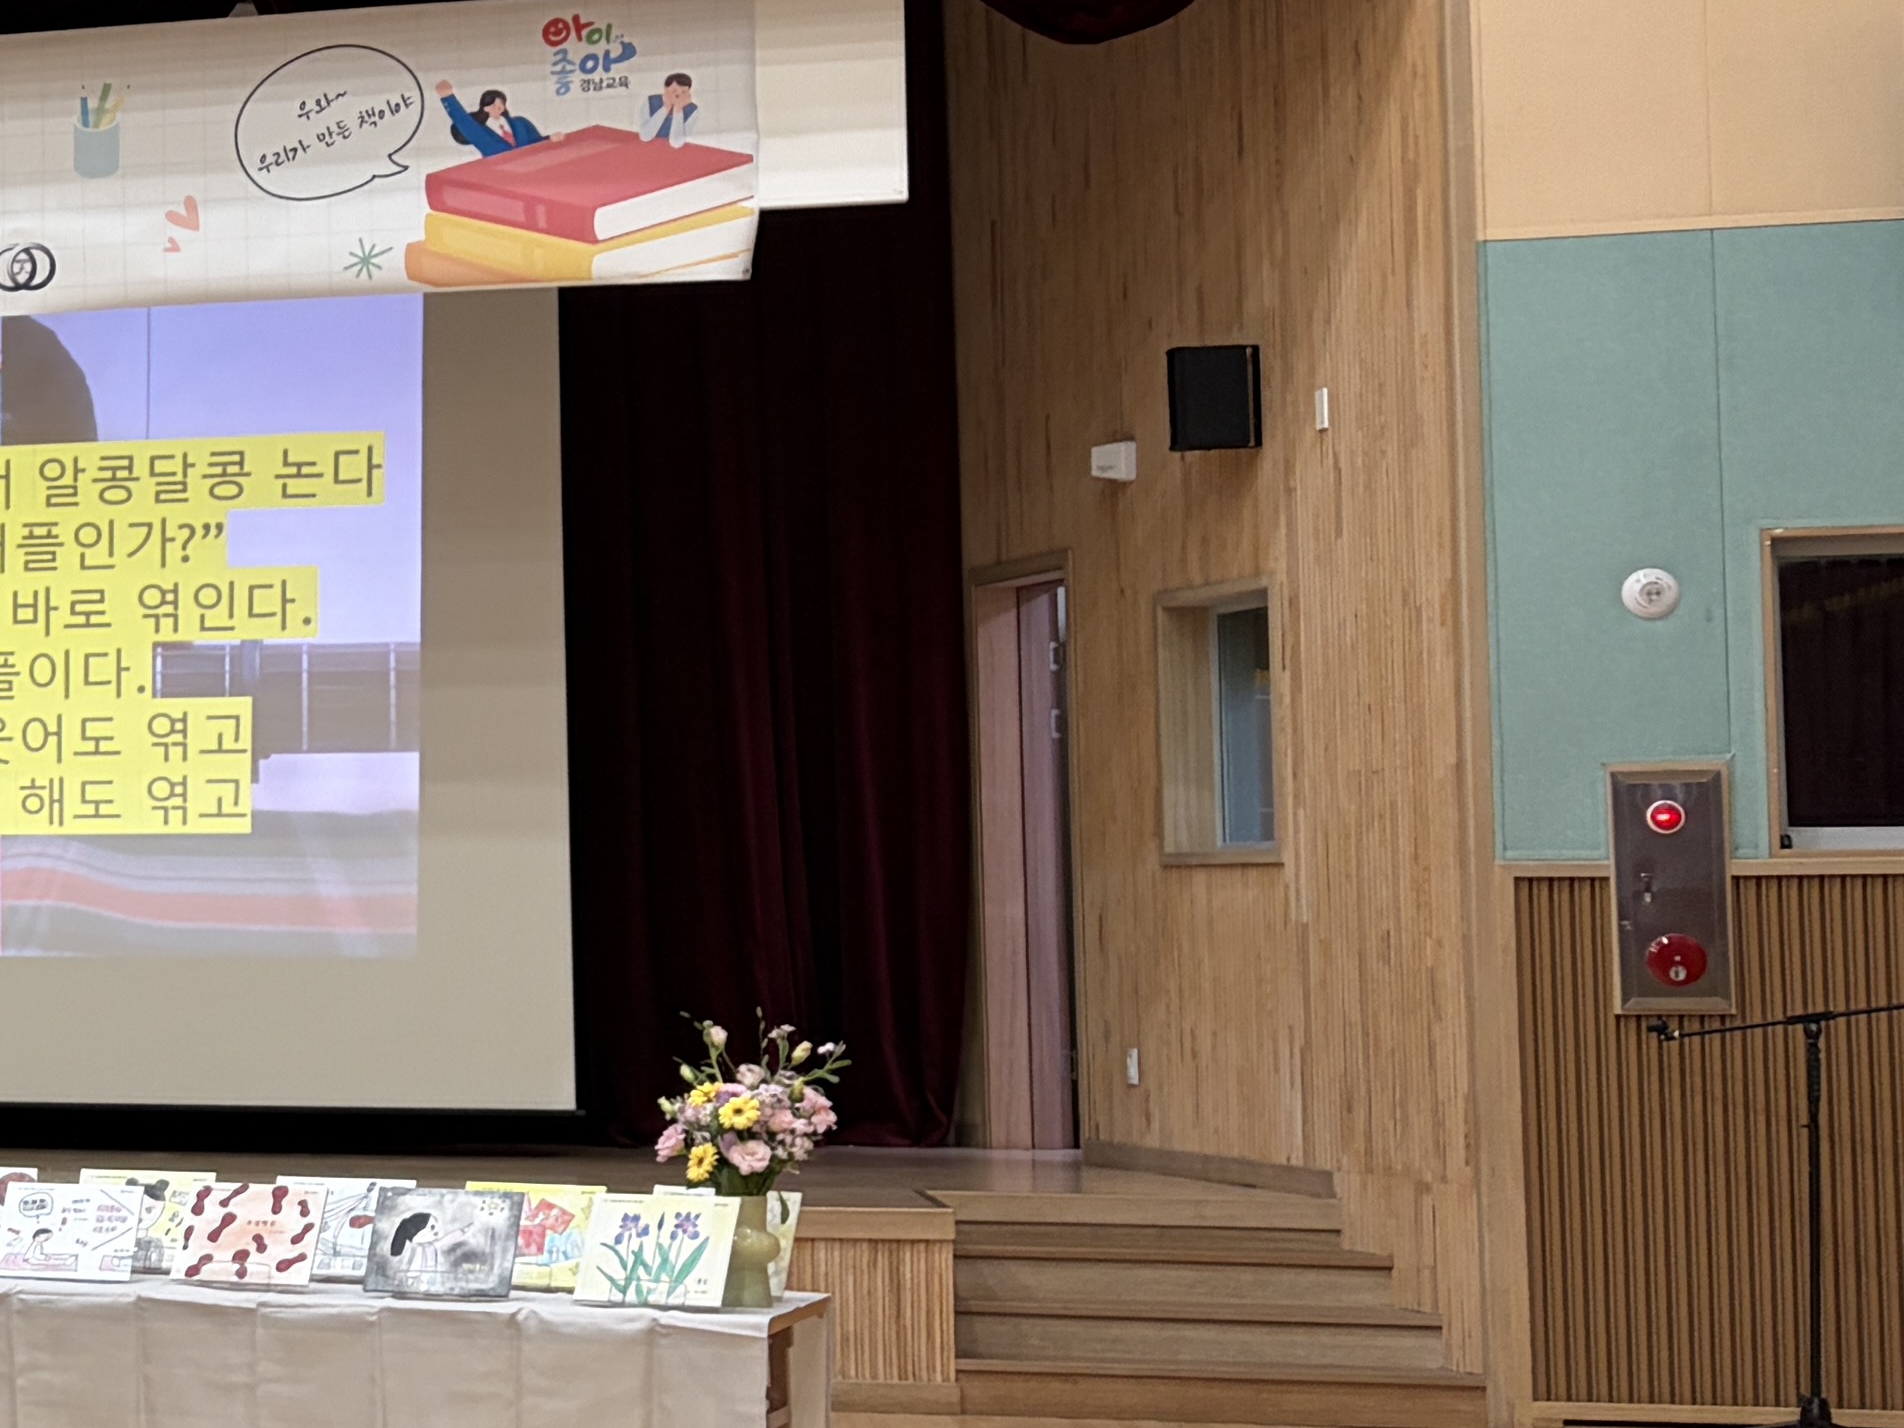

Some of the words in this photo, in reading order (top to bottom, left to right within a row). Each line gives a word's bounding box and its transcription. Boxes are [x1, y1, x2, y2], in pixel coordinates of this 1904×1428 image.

[580, 75, 630, 93] 경남교육
[258, 139, 311, 173] 우리가
[317, 120, 352, 148] 만든
[357, 93, 415, 129] 책이야
[39, 450, 252, 508] 알콩달콩
[275, 445, 382, 499] 논다
[13, 586, 112, 637] 바로
[138, 579, 311, 634] 엮인다.
[148, 711, 247, 762] 엮고
[19, 776, 121, 826] 해도
[147, 775, 247, 826] 엮고
